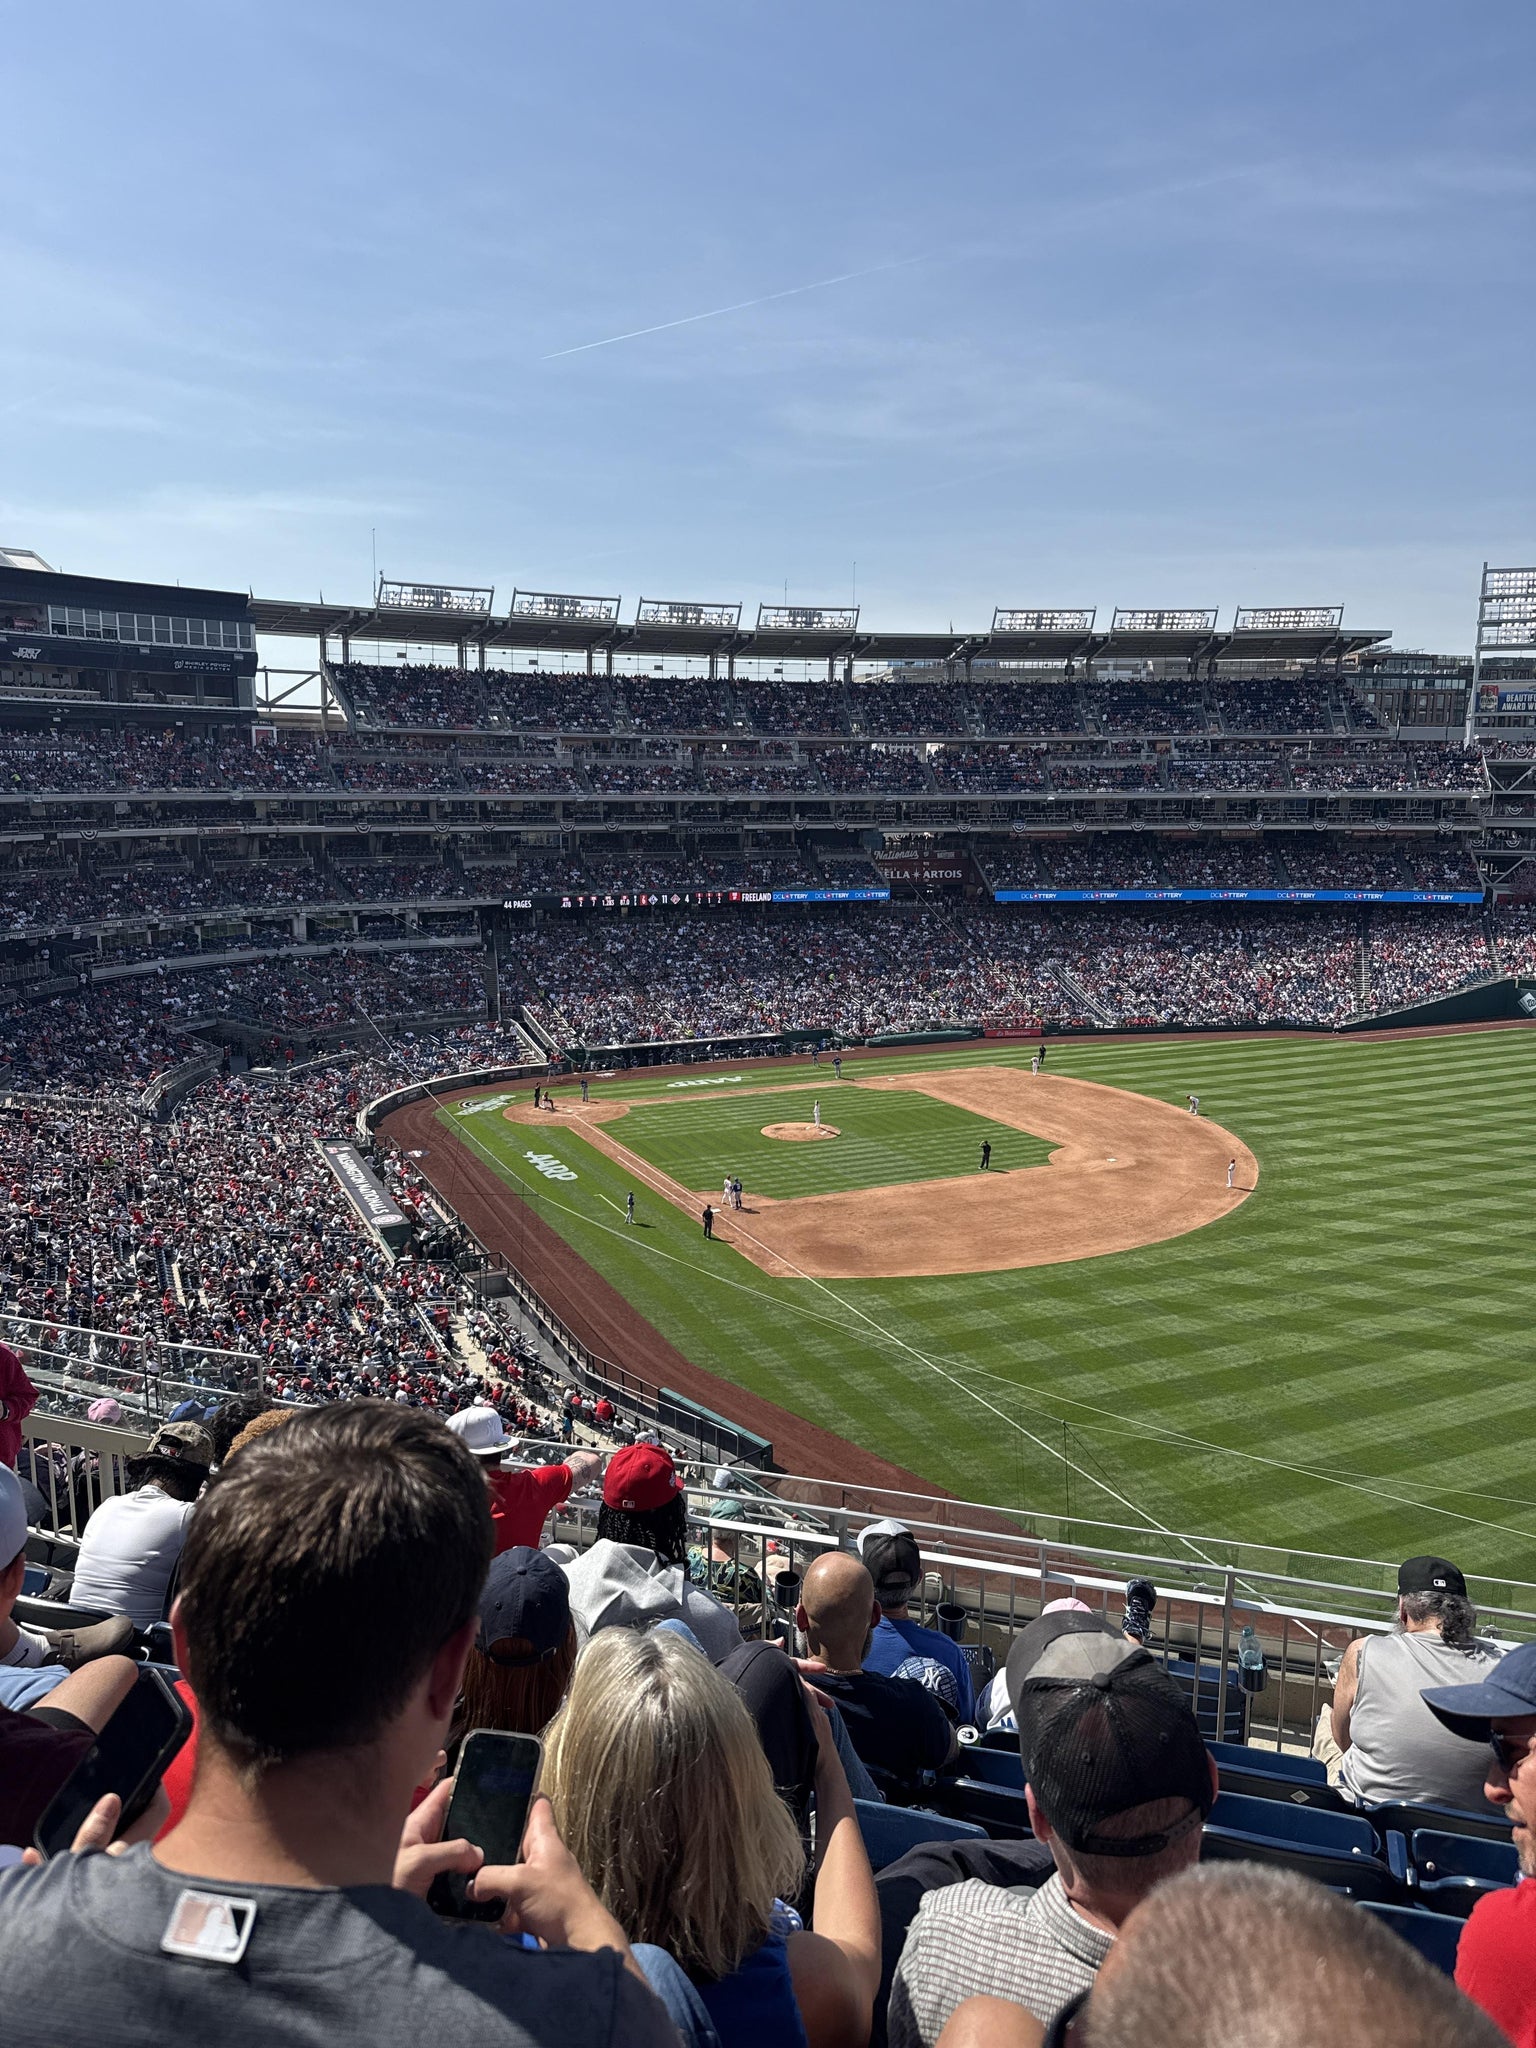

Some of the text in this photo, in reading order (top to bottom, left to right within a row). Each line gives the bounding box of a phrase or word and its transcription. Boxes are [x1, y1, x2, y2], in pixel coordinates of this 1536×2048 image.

[1502, 702, 1526, 710] AWARD
[874, 850, 919, 860] Nationals
[883, 870, 962, 879] ELLA ARTOIS
[661, 894, 668, 904] 11
[684, 894, 690, 903] 4
[741, 892, 772, 902] FREELAND
[503, 900, 532, 909] 44 PAGES
[522, 1151, 579, 1181] AARP
[336, 1152, 389, 1214] WASHINGTON NATIONALS
[922, 1667, 941, 1690] NY
